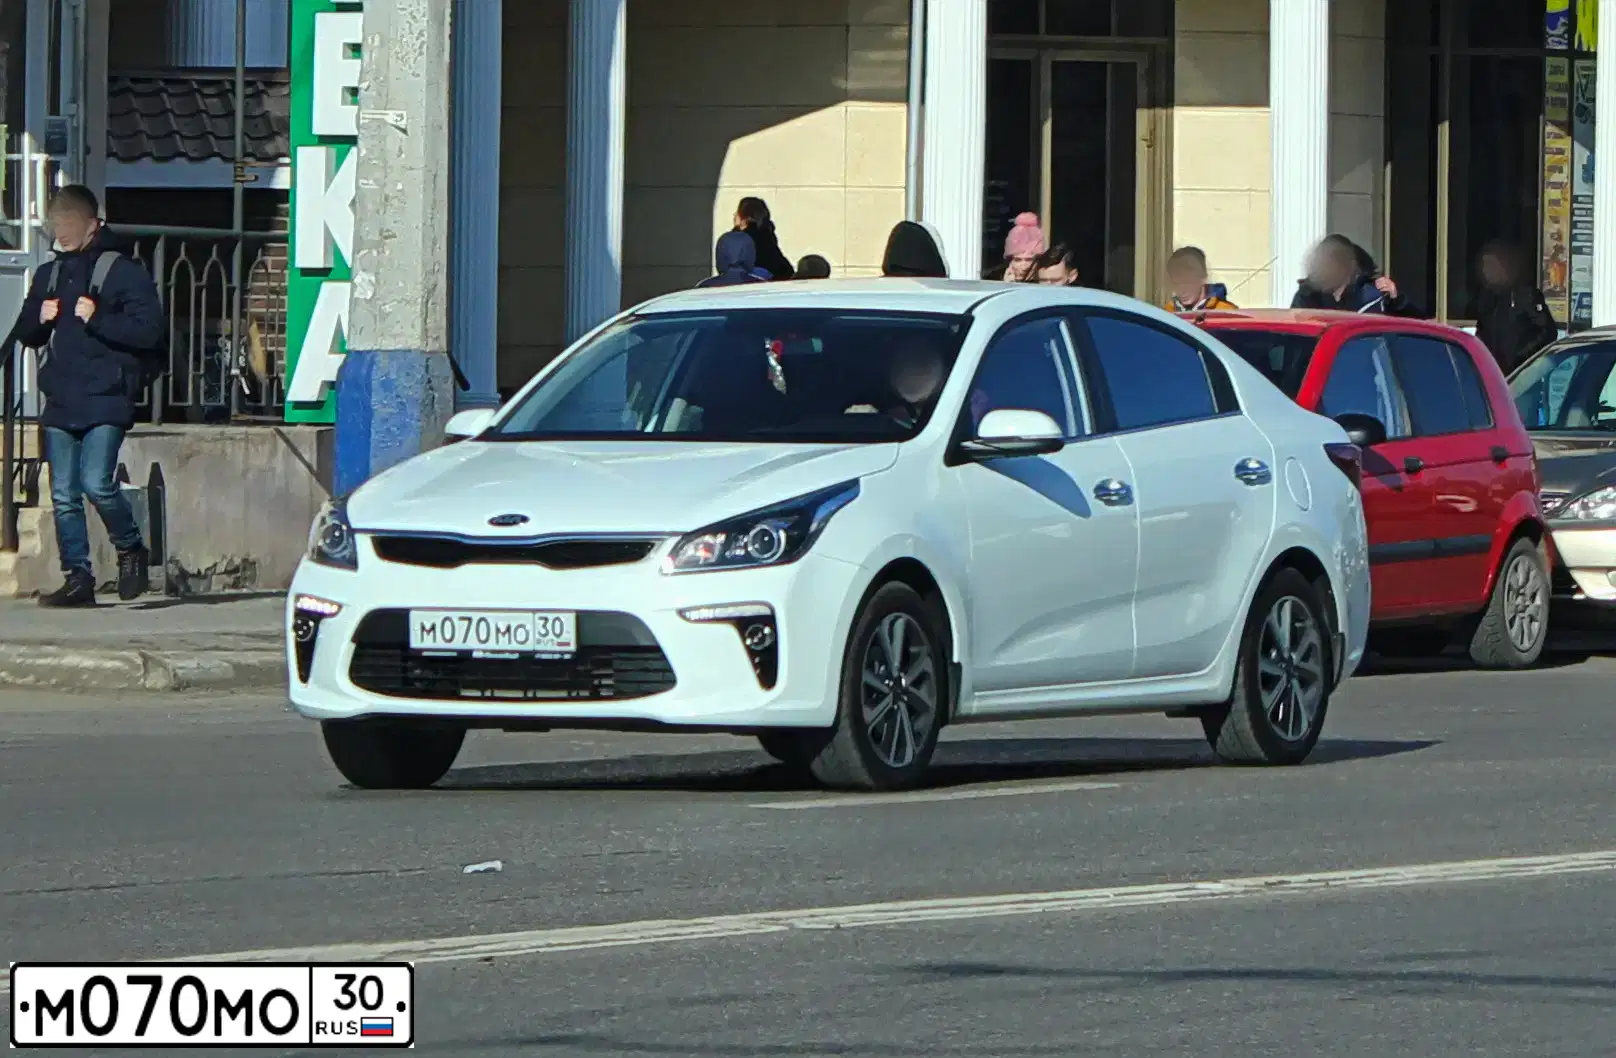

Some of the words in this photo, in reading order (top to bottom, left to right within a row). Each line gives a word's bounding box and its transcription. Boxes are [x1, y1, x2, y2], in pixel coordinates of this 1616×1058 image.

[286, 0, 363, 402] ЕКА
[420, 616, 530, 645] М070МО
[538, 616, 564, 638] 30
